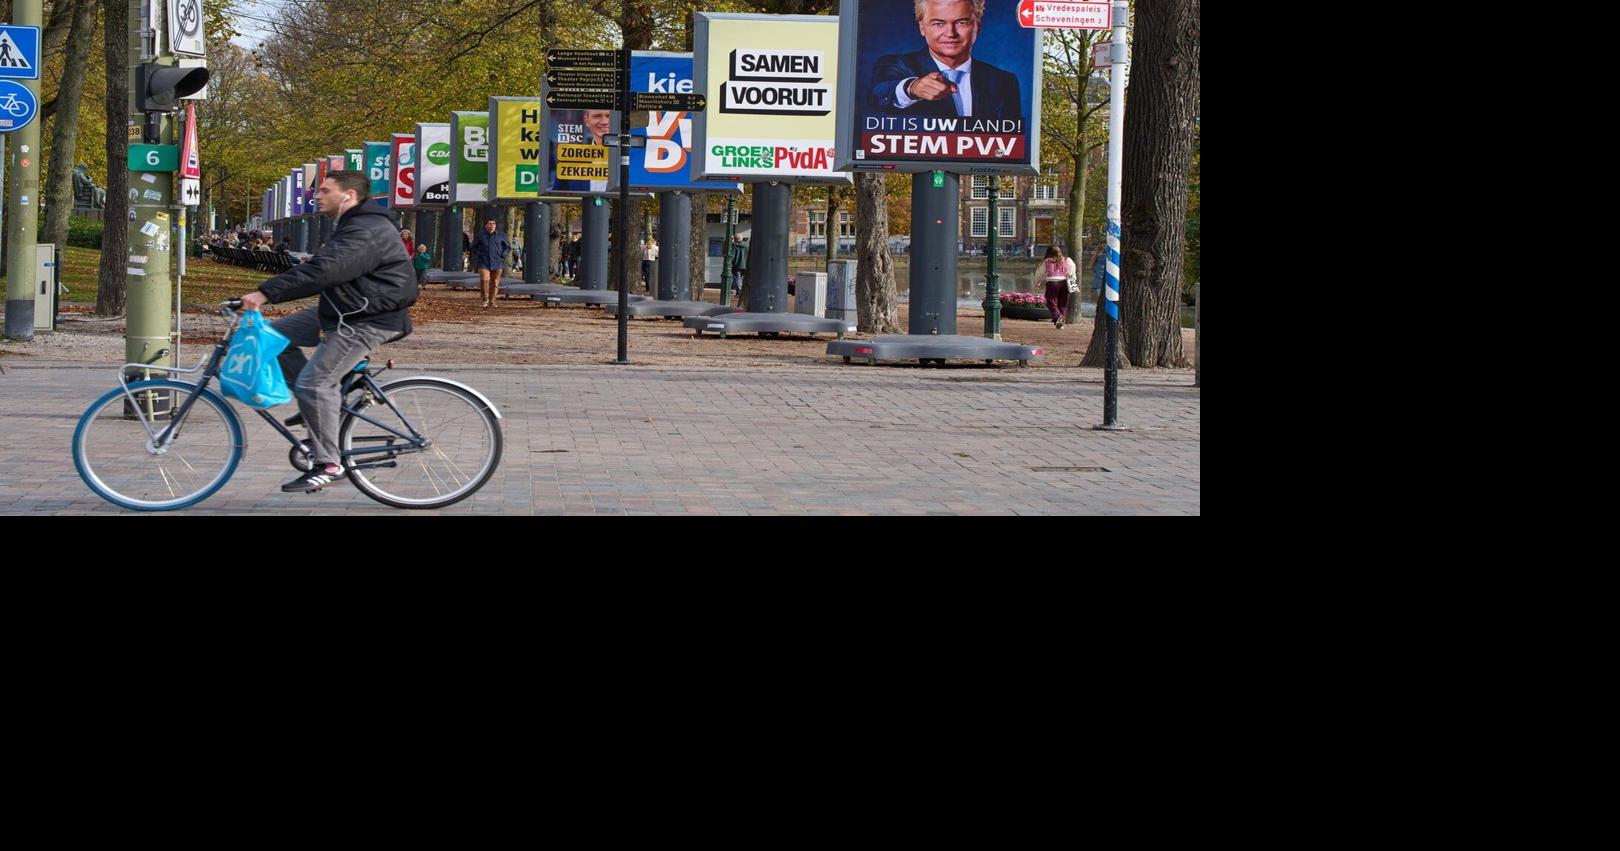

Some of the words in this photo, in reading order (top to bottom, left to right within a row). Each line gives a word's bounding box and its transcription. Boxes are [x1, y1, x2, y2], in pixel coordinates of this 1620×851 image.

[1047, 4, 1101, 13] Vredespaleis
[1035, 15, 1095, 25] Scheveningen
[741, 54, 819, 73] SAMEN
[731, 87, 827, 106] VOORUIT
[558, 123, 583, 133] STEM
[866, 116, 898, 131] DIT
[903, 117, 918, 131] IS
[923, 118, 957, 131] UW
[963, 119, 1021, 133] LAND!
[711, 145, 774, 157] GROEN
[870, 134, 949, 155] STEM
[957, 137, 1017, 156] PVV
[146, 150, 160, 166] 6
[561, 147, 604, 159] ZORGEN
[774, 147, 828, 169] PvdA
[721, 157, 774, 169] LINKS
[521, 171, 539, 185] D
